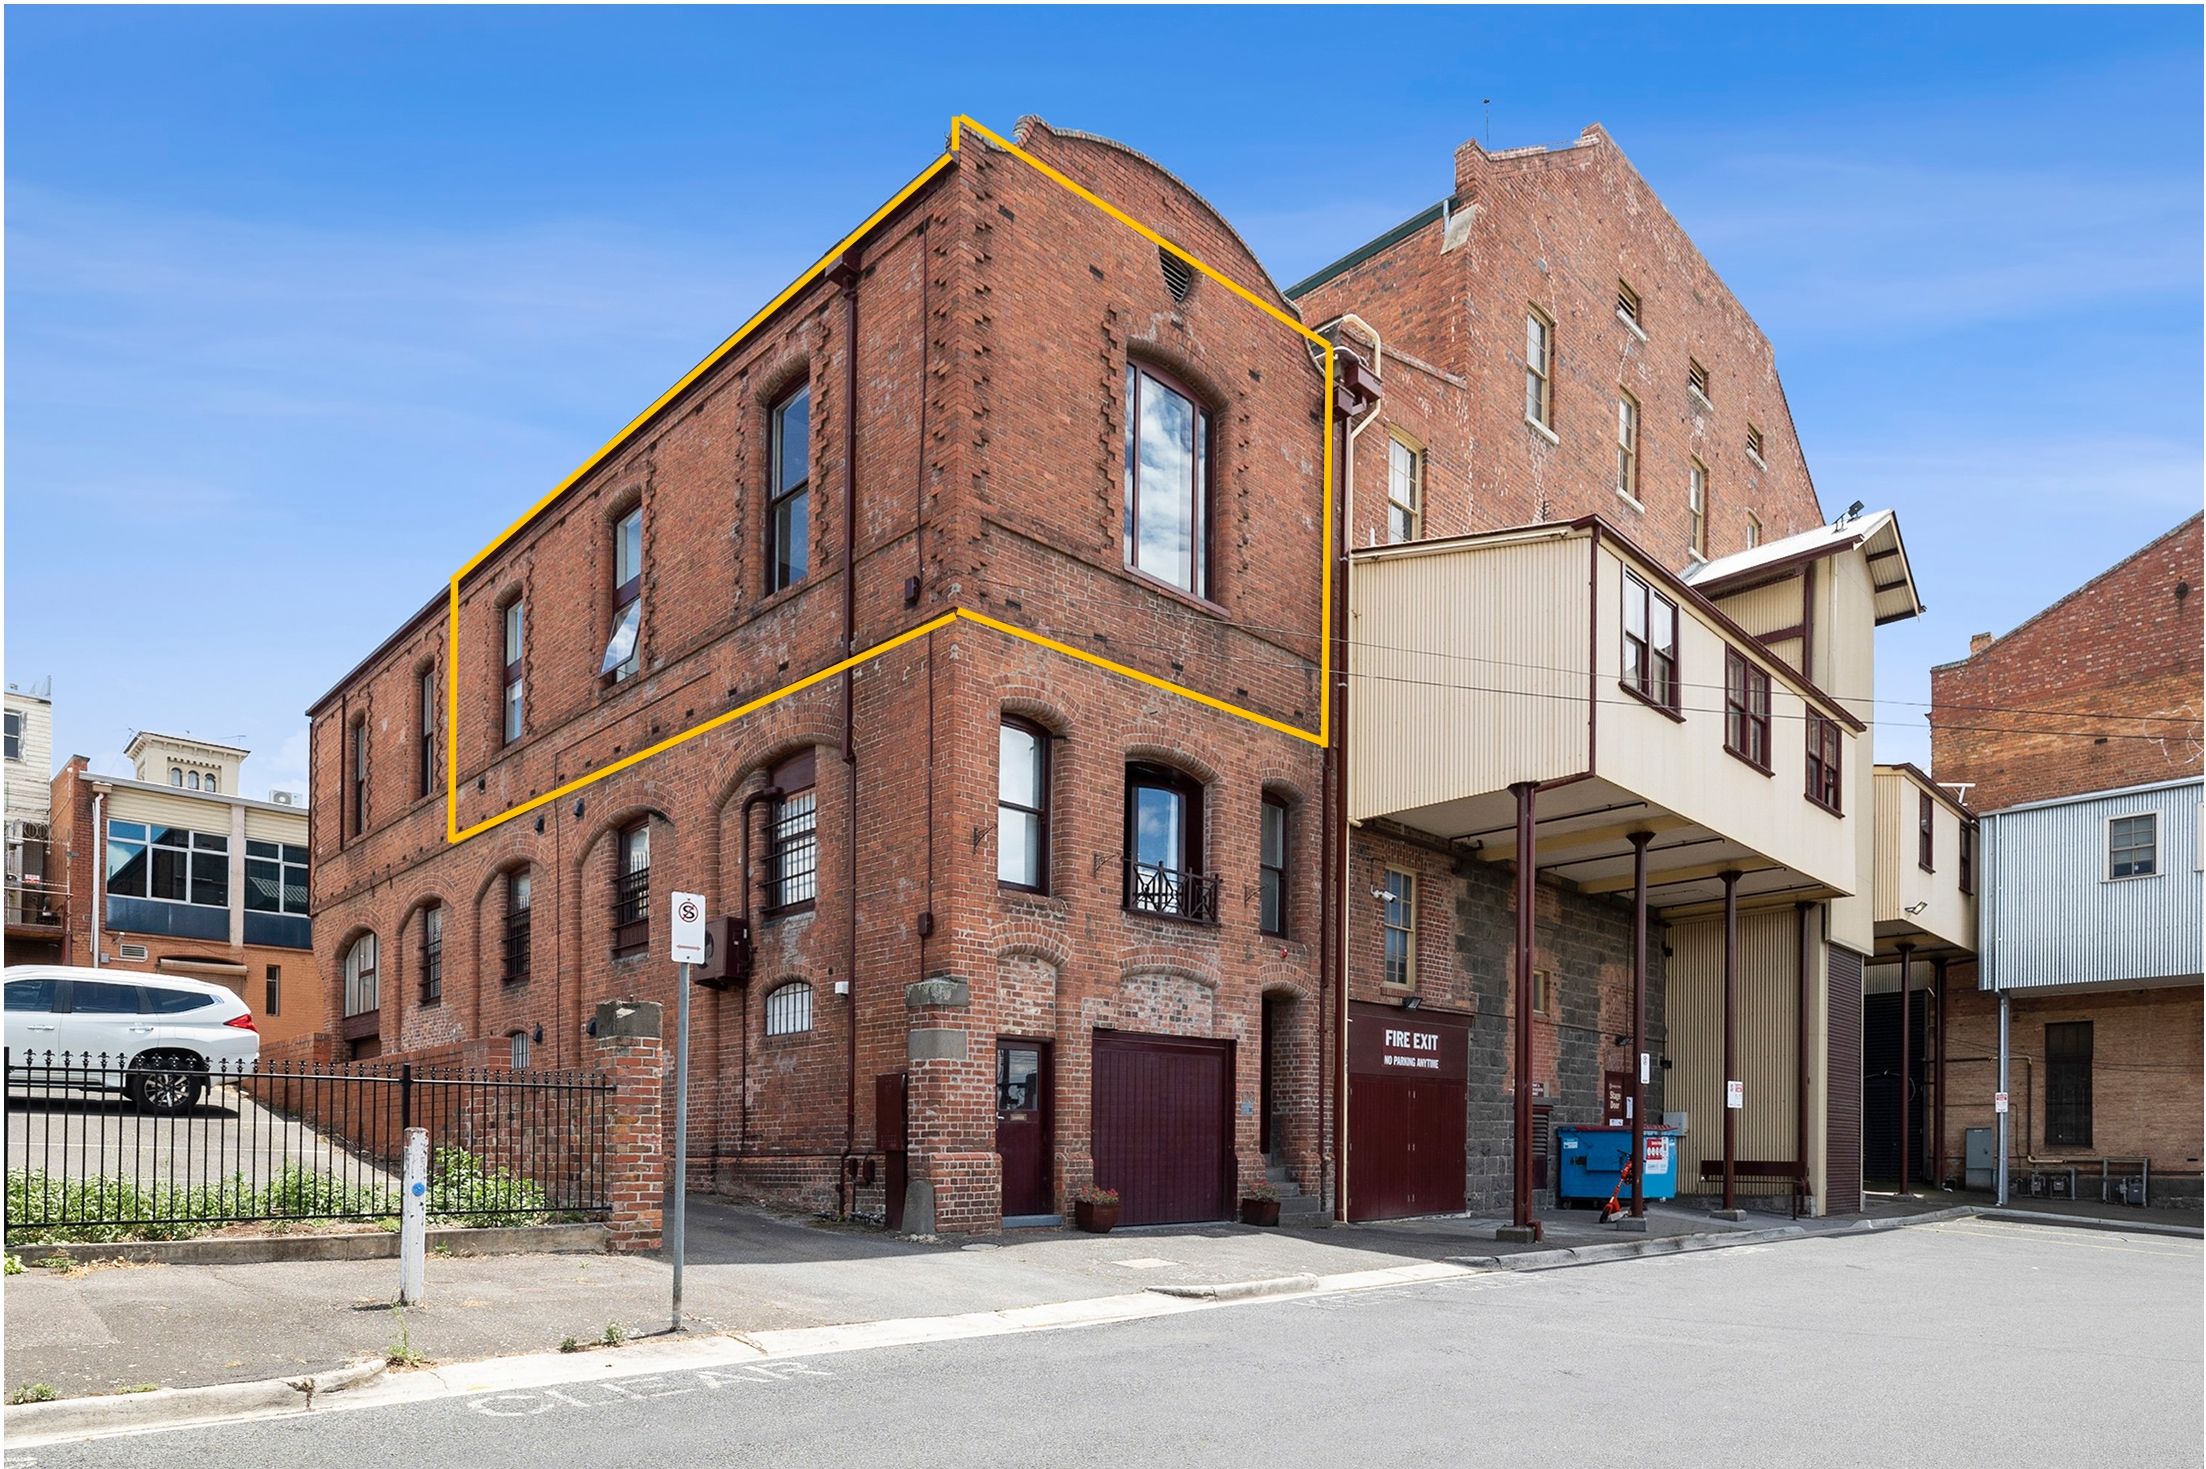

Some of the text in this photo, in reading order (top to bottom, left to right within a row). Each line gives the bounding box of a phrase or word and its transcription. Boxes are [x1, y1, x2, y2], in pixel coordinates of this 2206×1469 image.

[1385, 1029, 1439, 1051] FIRE EXIT
[1383, 1055, 1439, 1069] NO PARKING ANYTIME
[466, 1361, 833, 1417] CLEAR
